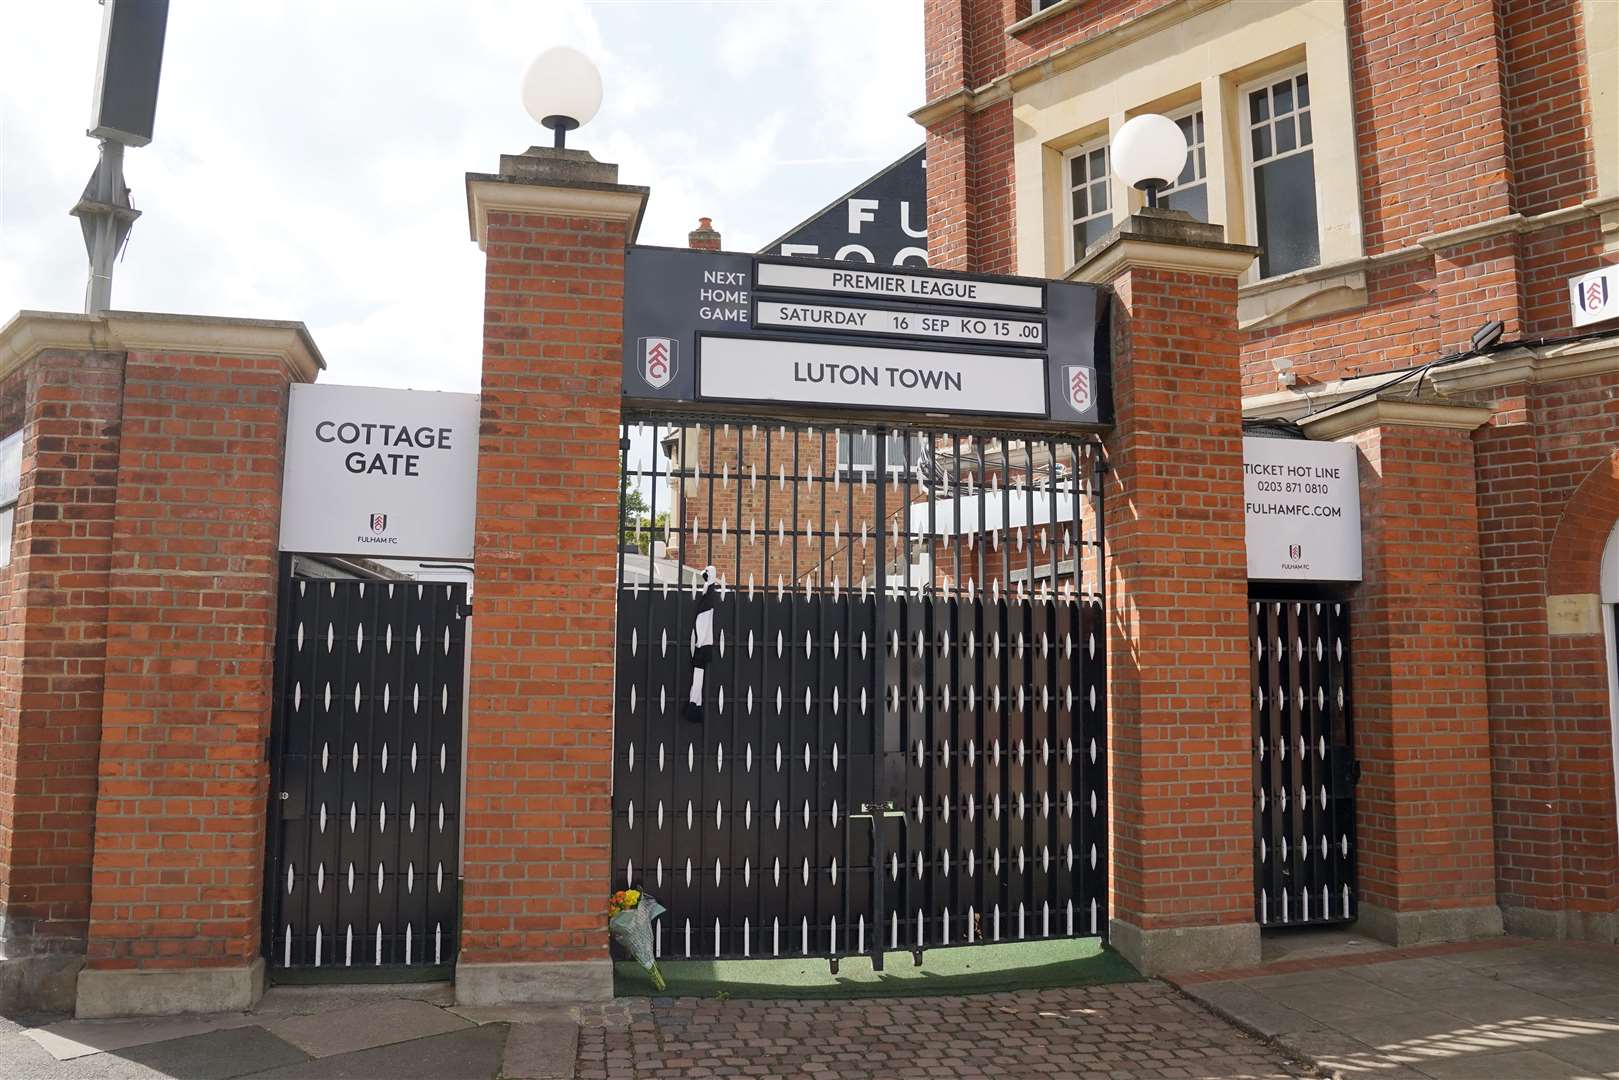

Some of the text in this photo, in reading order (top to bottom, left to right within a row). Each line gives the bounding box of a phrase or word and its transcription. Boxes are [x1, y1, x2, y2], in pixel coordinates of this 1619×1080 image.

[704, 270, 746, 286] NEXT
[832, 272, 977, 299] PREMIER LEAGUE
[700, 288, 748, 305] HOME
[699, 307, 748, 322] GAME
[779, 306, 867, 326] SATURDAY
[893, 316, 909, 330] 16
[922, 318, 949, 332] SEP
[961, 319, 986, 335] KO
[993, 322, 1010, 336] 15
[794, 361, 963, 392] LUTON TOWN
[315, 420, 453, 450] COTTAGE
[345, 451, 420, 477] GATE
[1243, 463, 1341, 479] TICKET HOT LINE
[1257, 480, 1329, 495] 0203 871 0810
[1246, 502, 1342, 518] FULHAMFC.COM
[357, 535, 398, 545] FULHAM FC
